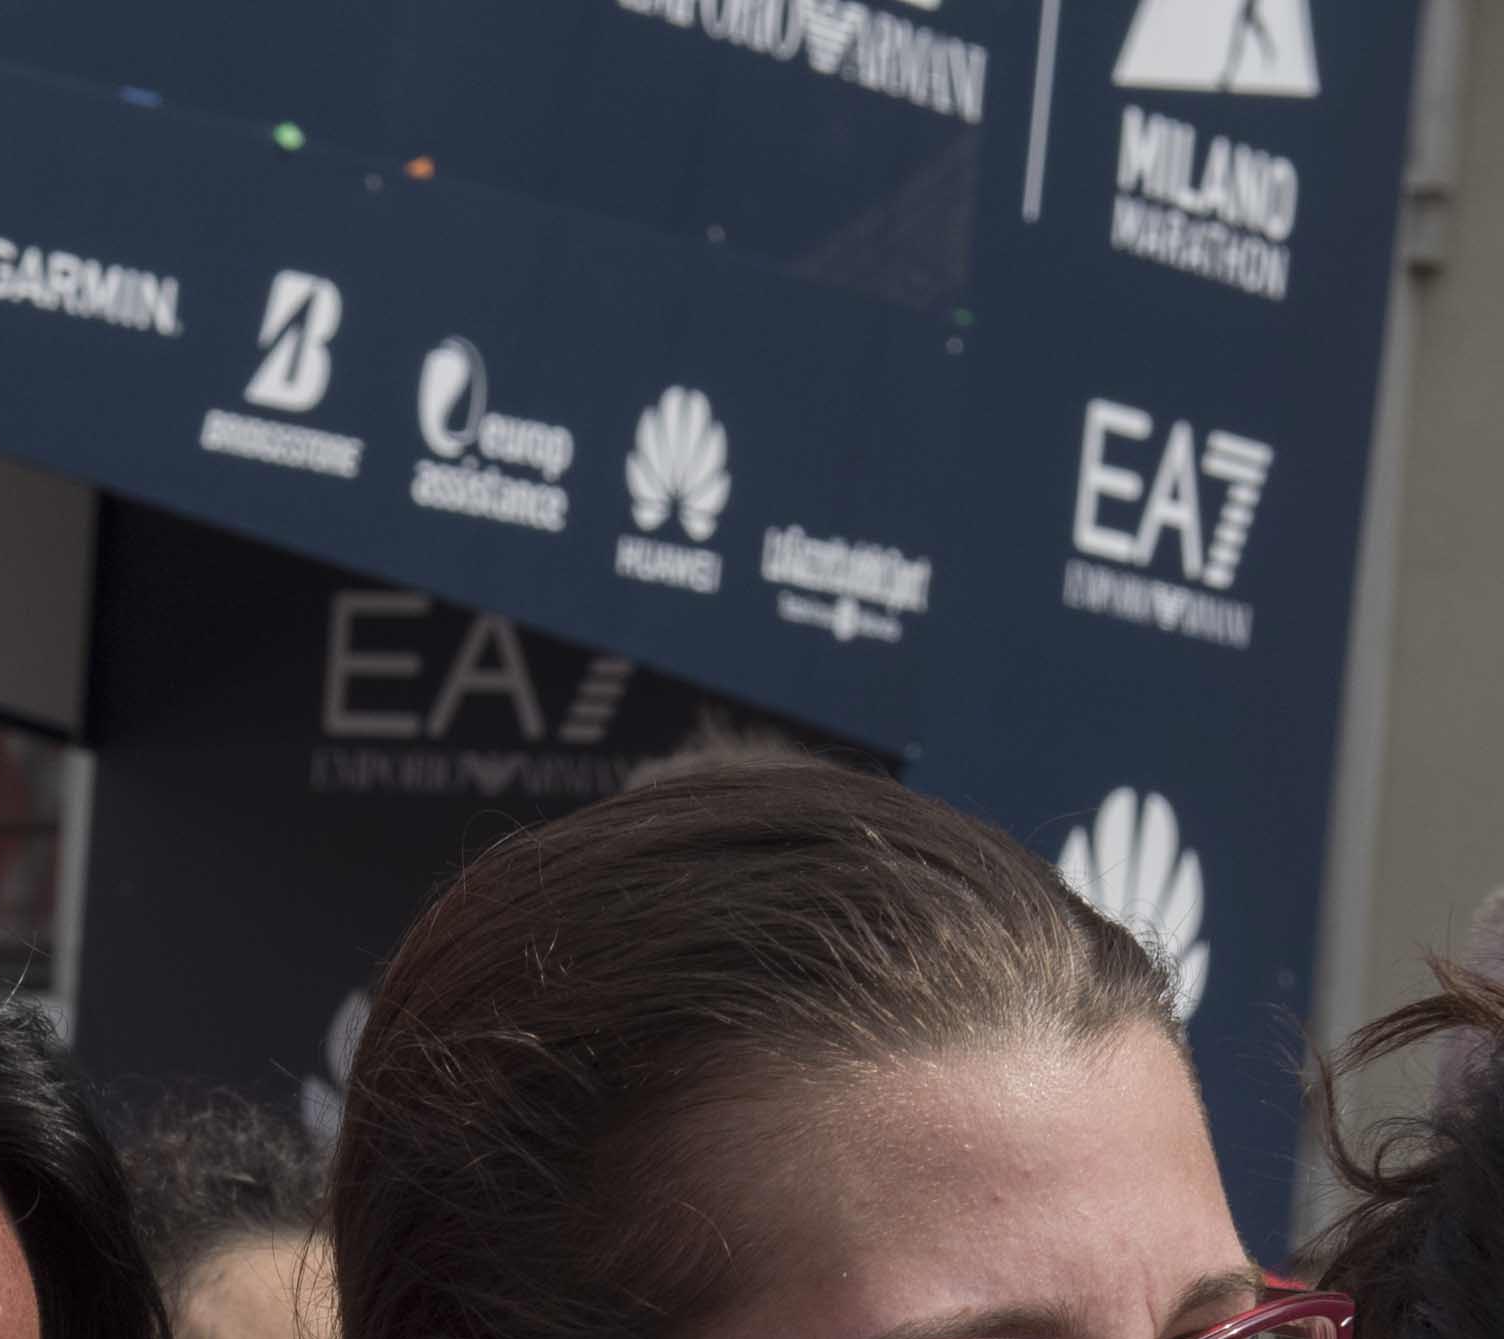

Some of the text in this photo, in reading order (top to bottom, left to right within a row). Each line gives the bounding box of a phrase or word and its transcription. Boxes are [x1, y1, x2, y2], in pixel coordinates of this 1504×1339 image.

[1119, 105, 1298, 243] MILANO
[1111, 194, 1290, 301] MARATHON
[201, 409, 365, 479] BRIDGESTONE
[479, 411, 573, 482] europ
[413, 459, 568, 533] assistance
[1073, 397, 1275, 591] EA7
